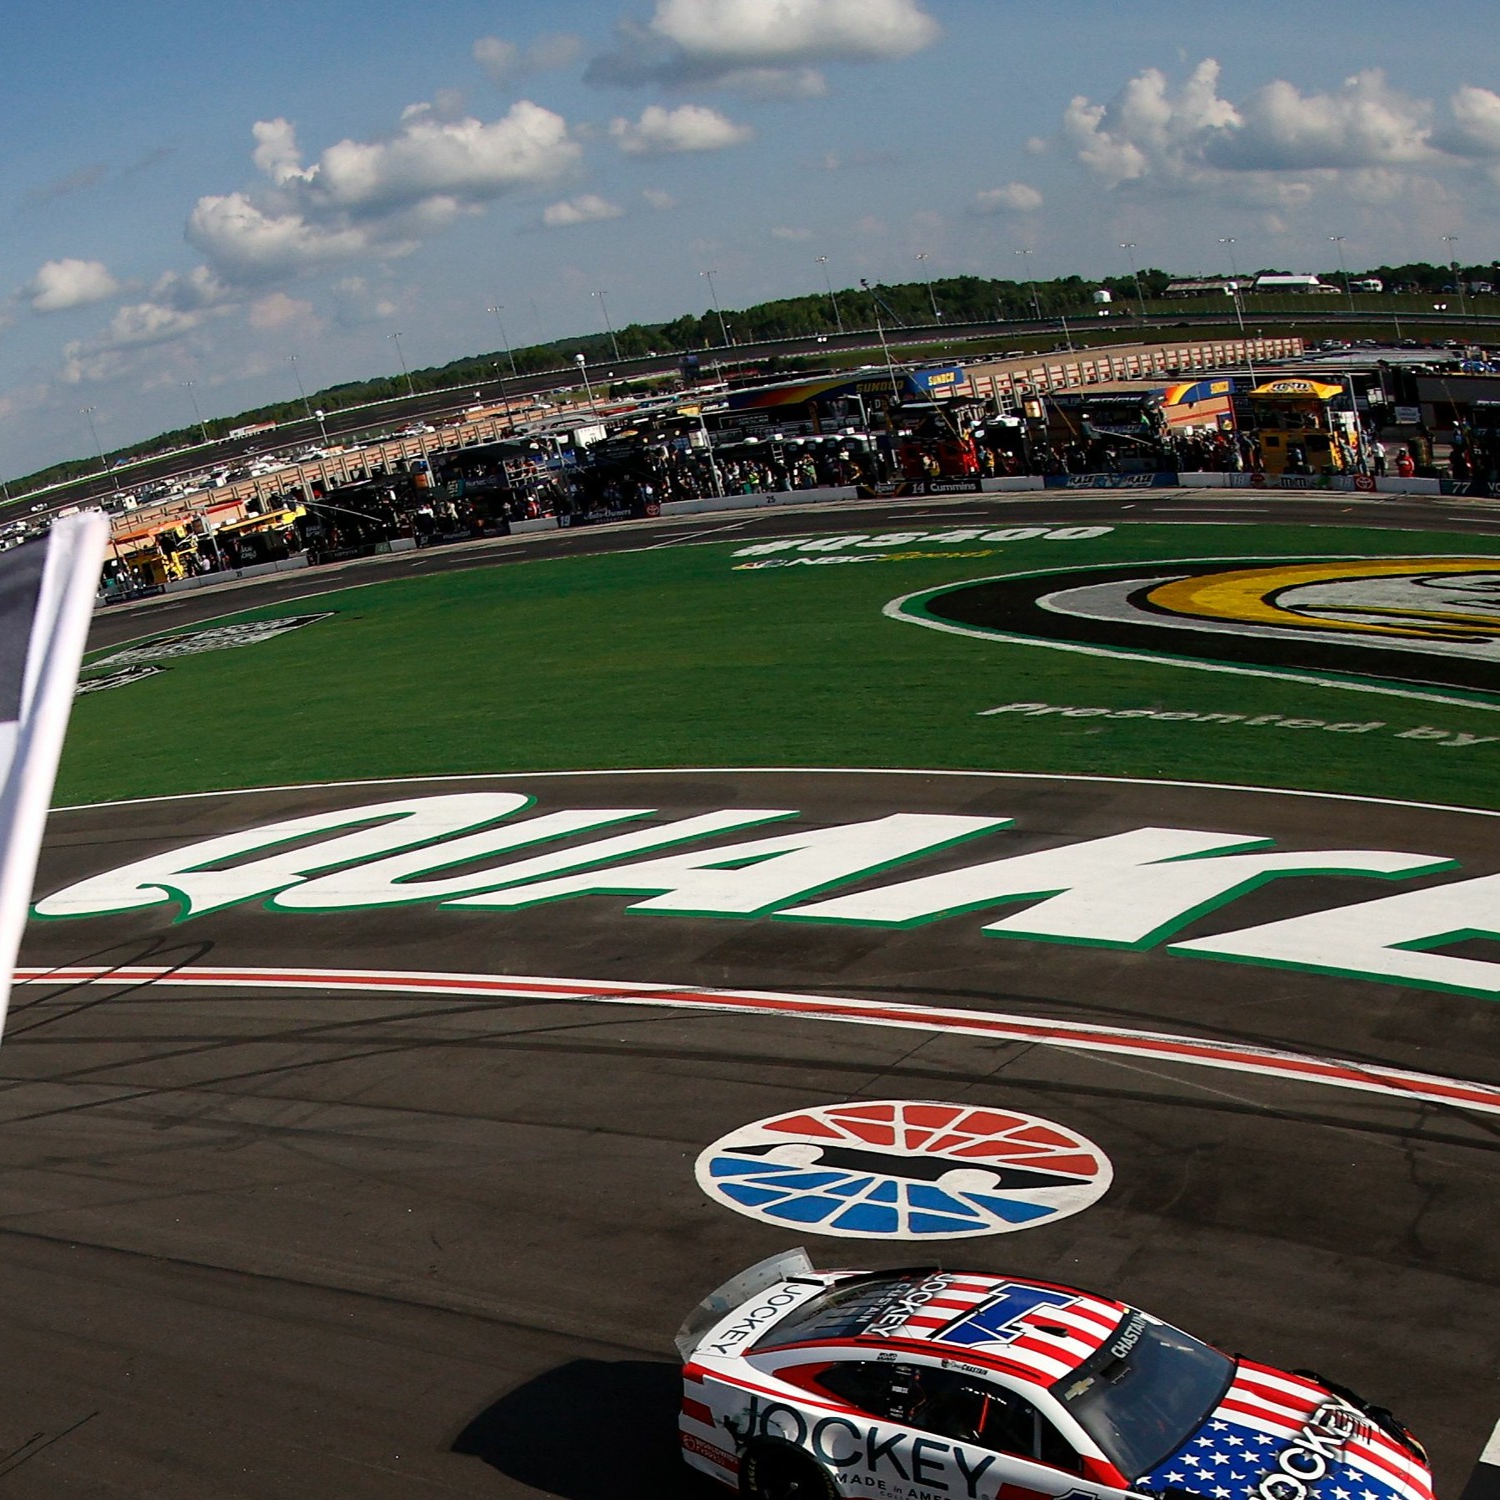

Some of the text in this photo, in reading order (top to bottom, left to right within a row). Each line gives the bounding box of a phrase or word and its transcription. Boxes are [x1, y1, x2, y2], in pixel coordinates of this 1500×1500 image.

[911, 481, 977, 494] 14 Cummins
[1452, 481, 1471, 494] 77
[561, 515, 571, 527] 19
[731, 525, 1115, 558] #QS400
[977, 702, 1500, 747] Presented by
[710, 1284, 802, 1354] JOCKEY
[872, 1273, 955, 1339] JOCKEY
[1110, 1314, 1148, 1359] CHASTAIN
[733, 1395, 996, 1499] JOCKEY
[834, 1473, 886, 1491] MADE
[893, 1485, 902, 1494] in
